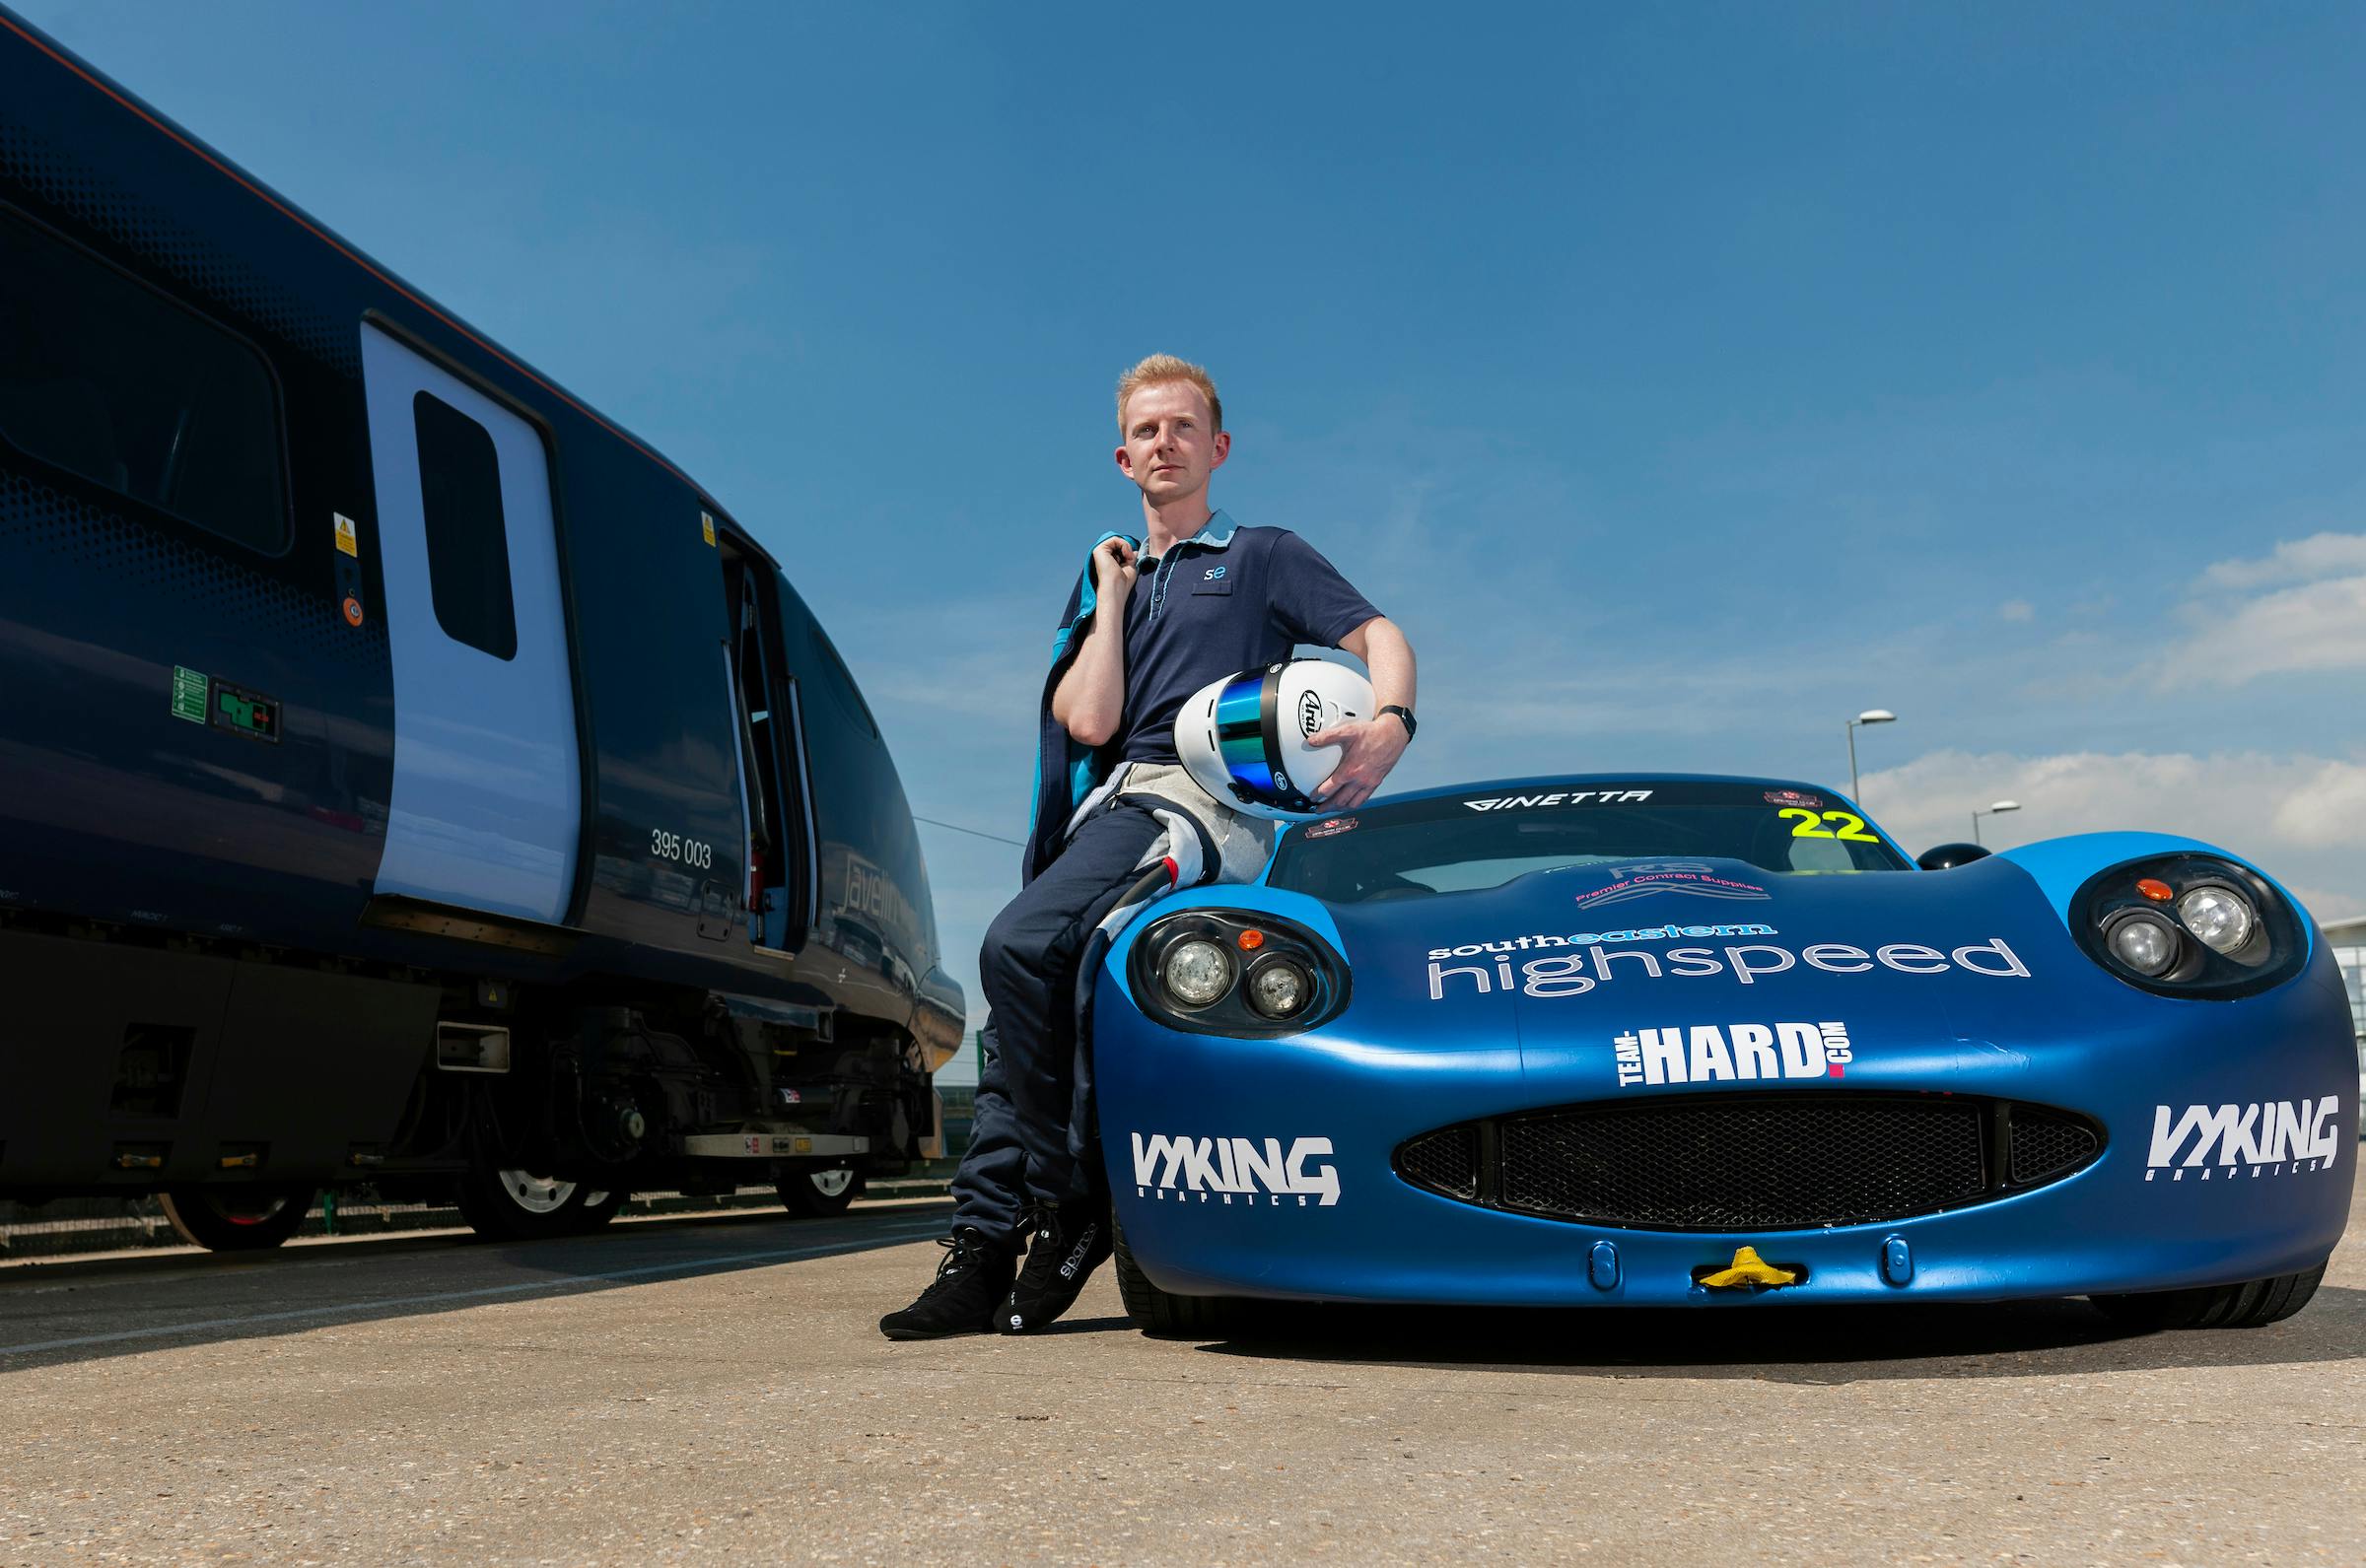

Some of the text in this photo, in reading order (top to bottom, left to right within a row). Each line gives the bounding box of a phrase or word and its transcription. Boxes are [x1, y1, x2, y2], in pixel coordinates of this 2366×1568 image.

[1204, 566, 1226, 580] se
[1303, 693, 1320, 735] Arai
[1463, 790, 1653, 812] GINETTA
[1777, 808, 1880, 844] 22
[651, 828, 712, 869] 395 003
[1575, 872, 1764, 901] Premier Contract Supplies
[1427, 923, 1778, 961] southeastern
[1427, 938, 2032, 1000] highspeed
[1638, 1022, 1827, 1085] HARD
[2147, 1095, 2339, 1170] VYKING
[1132, 1132, 1341, 1205] VYKING
[2144, 1159, 2318, 1182] GRAPHICS
[1138, 1187, 1306, 1206] GRAPHICS
[1061, 1223, 1096, 1278] sparco
